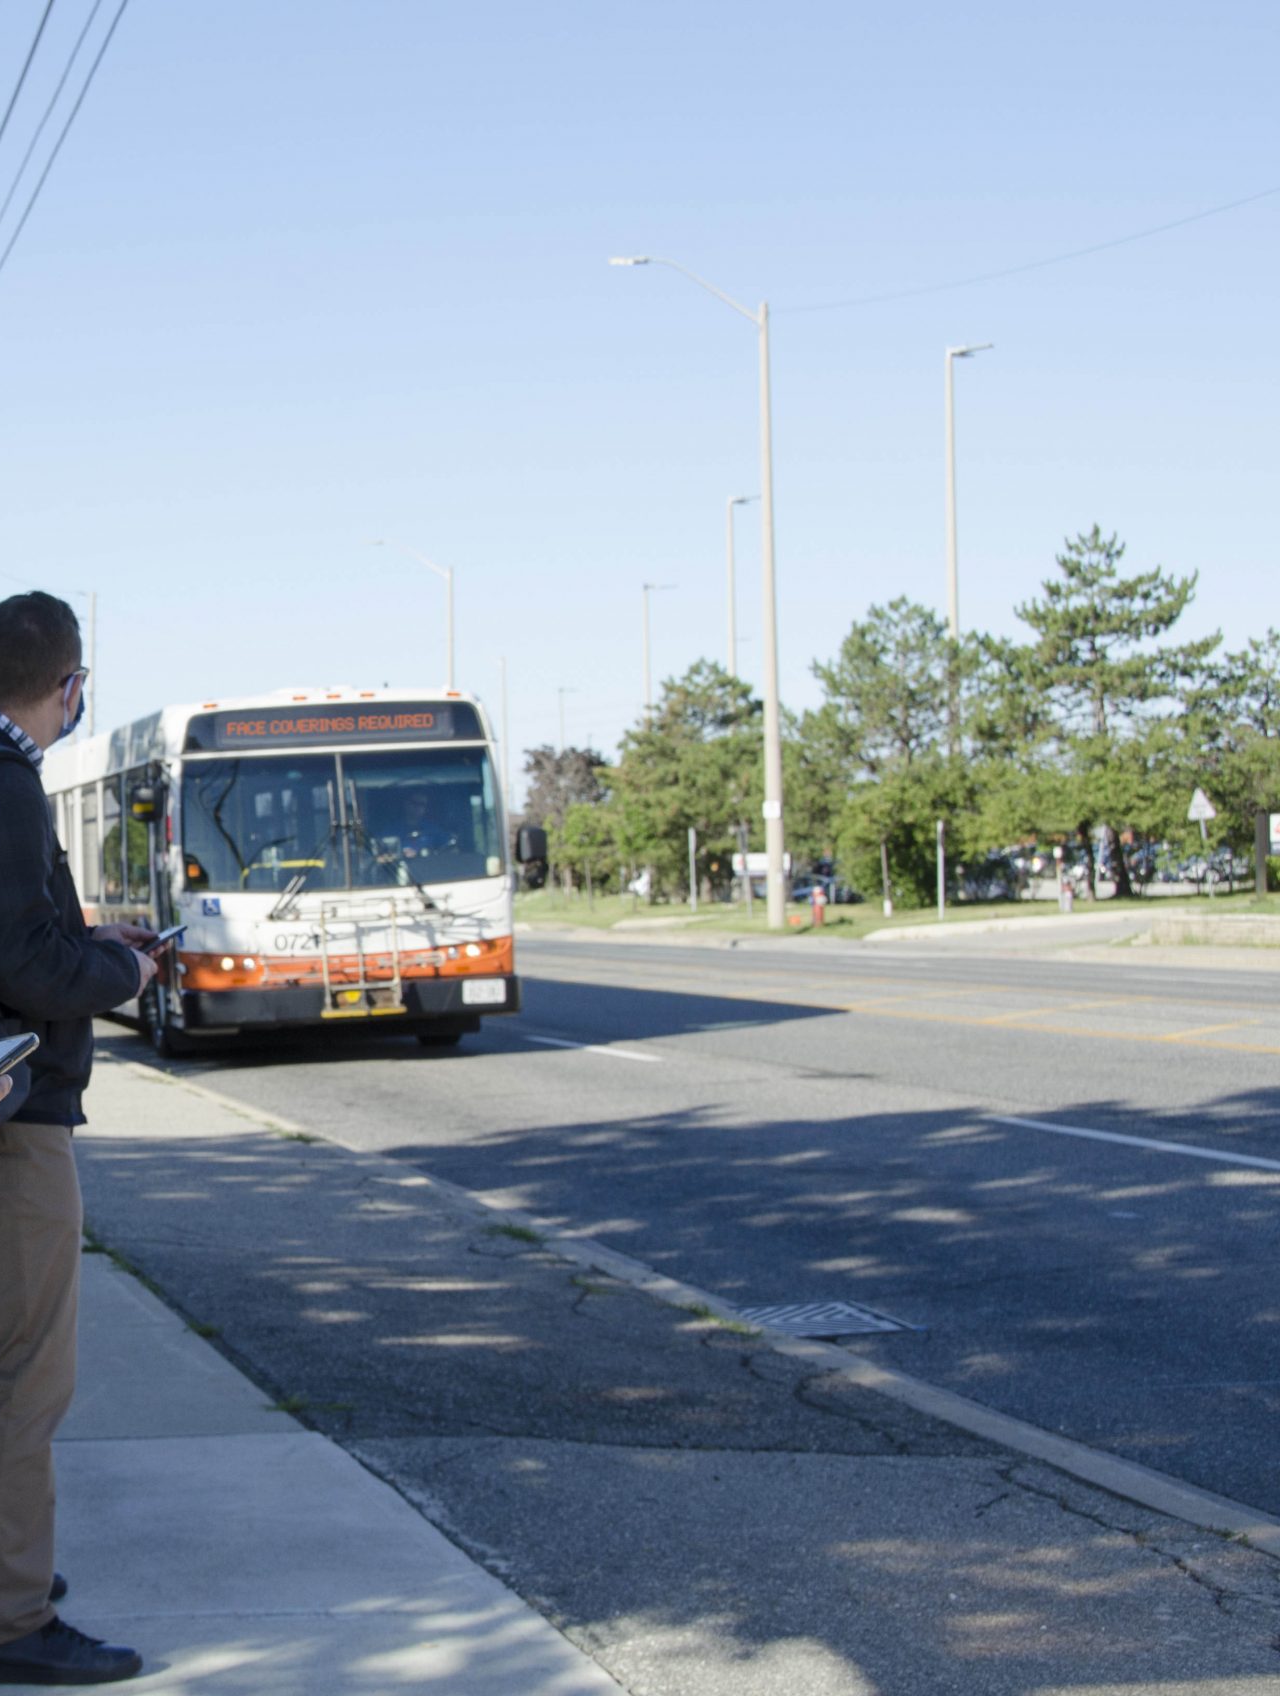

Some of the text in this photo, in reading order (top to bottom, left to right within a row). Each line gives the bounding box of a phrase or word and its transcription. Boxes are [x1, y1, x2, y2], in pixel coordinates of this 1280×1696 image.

[226, 713, 433, 736] FACE COVERINGS REQUIRED
